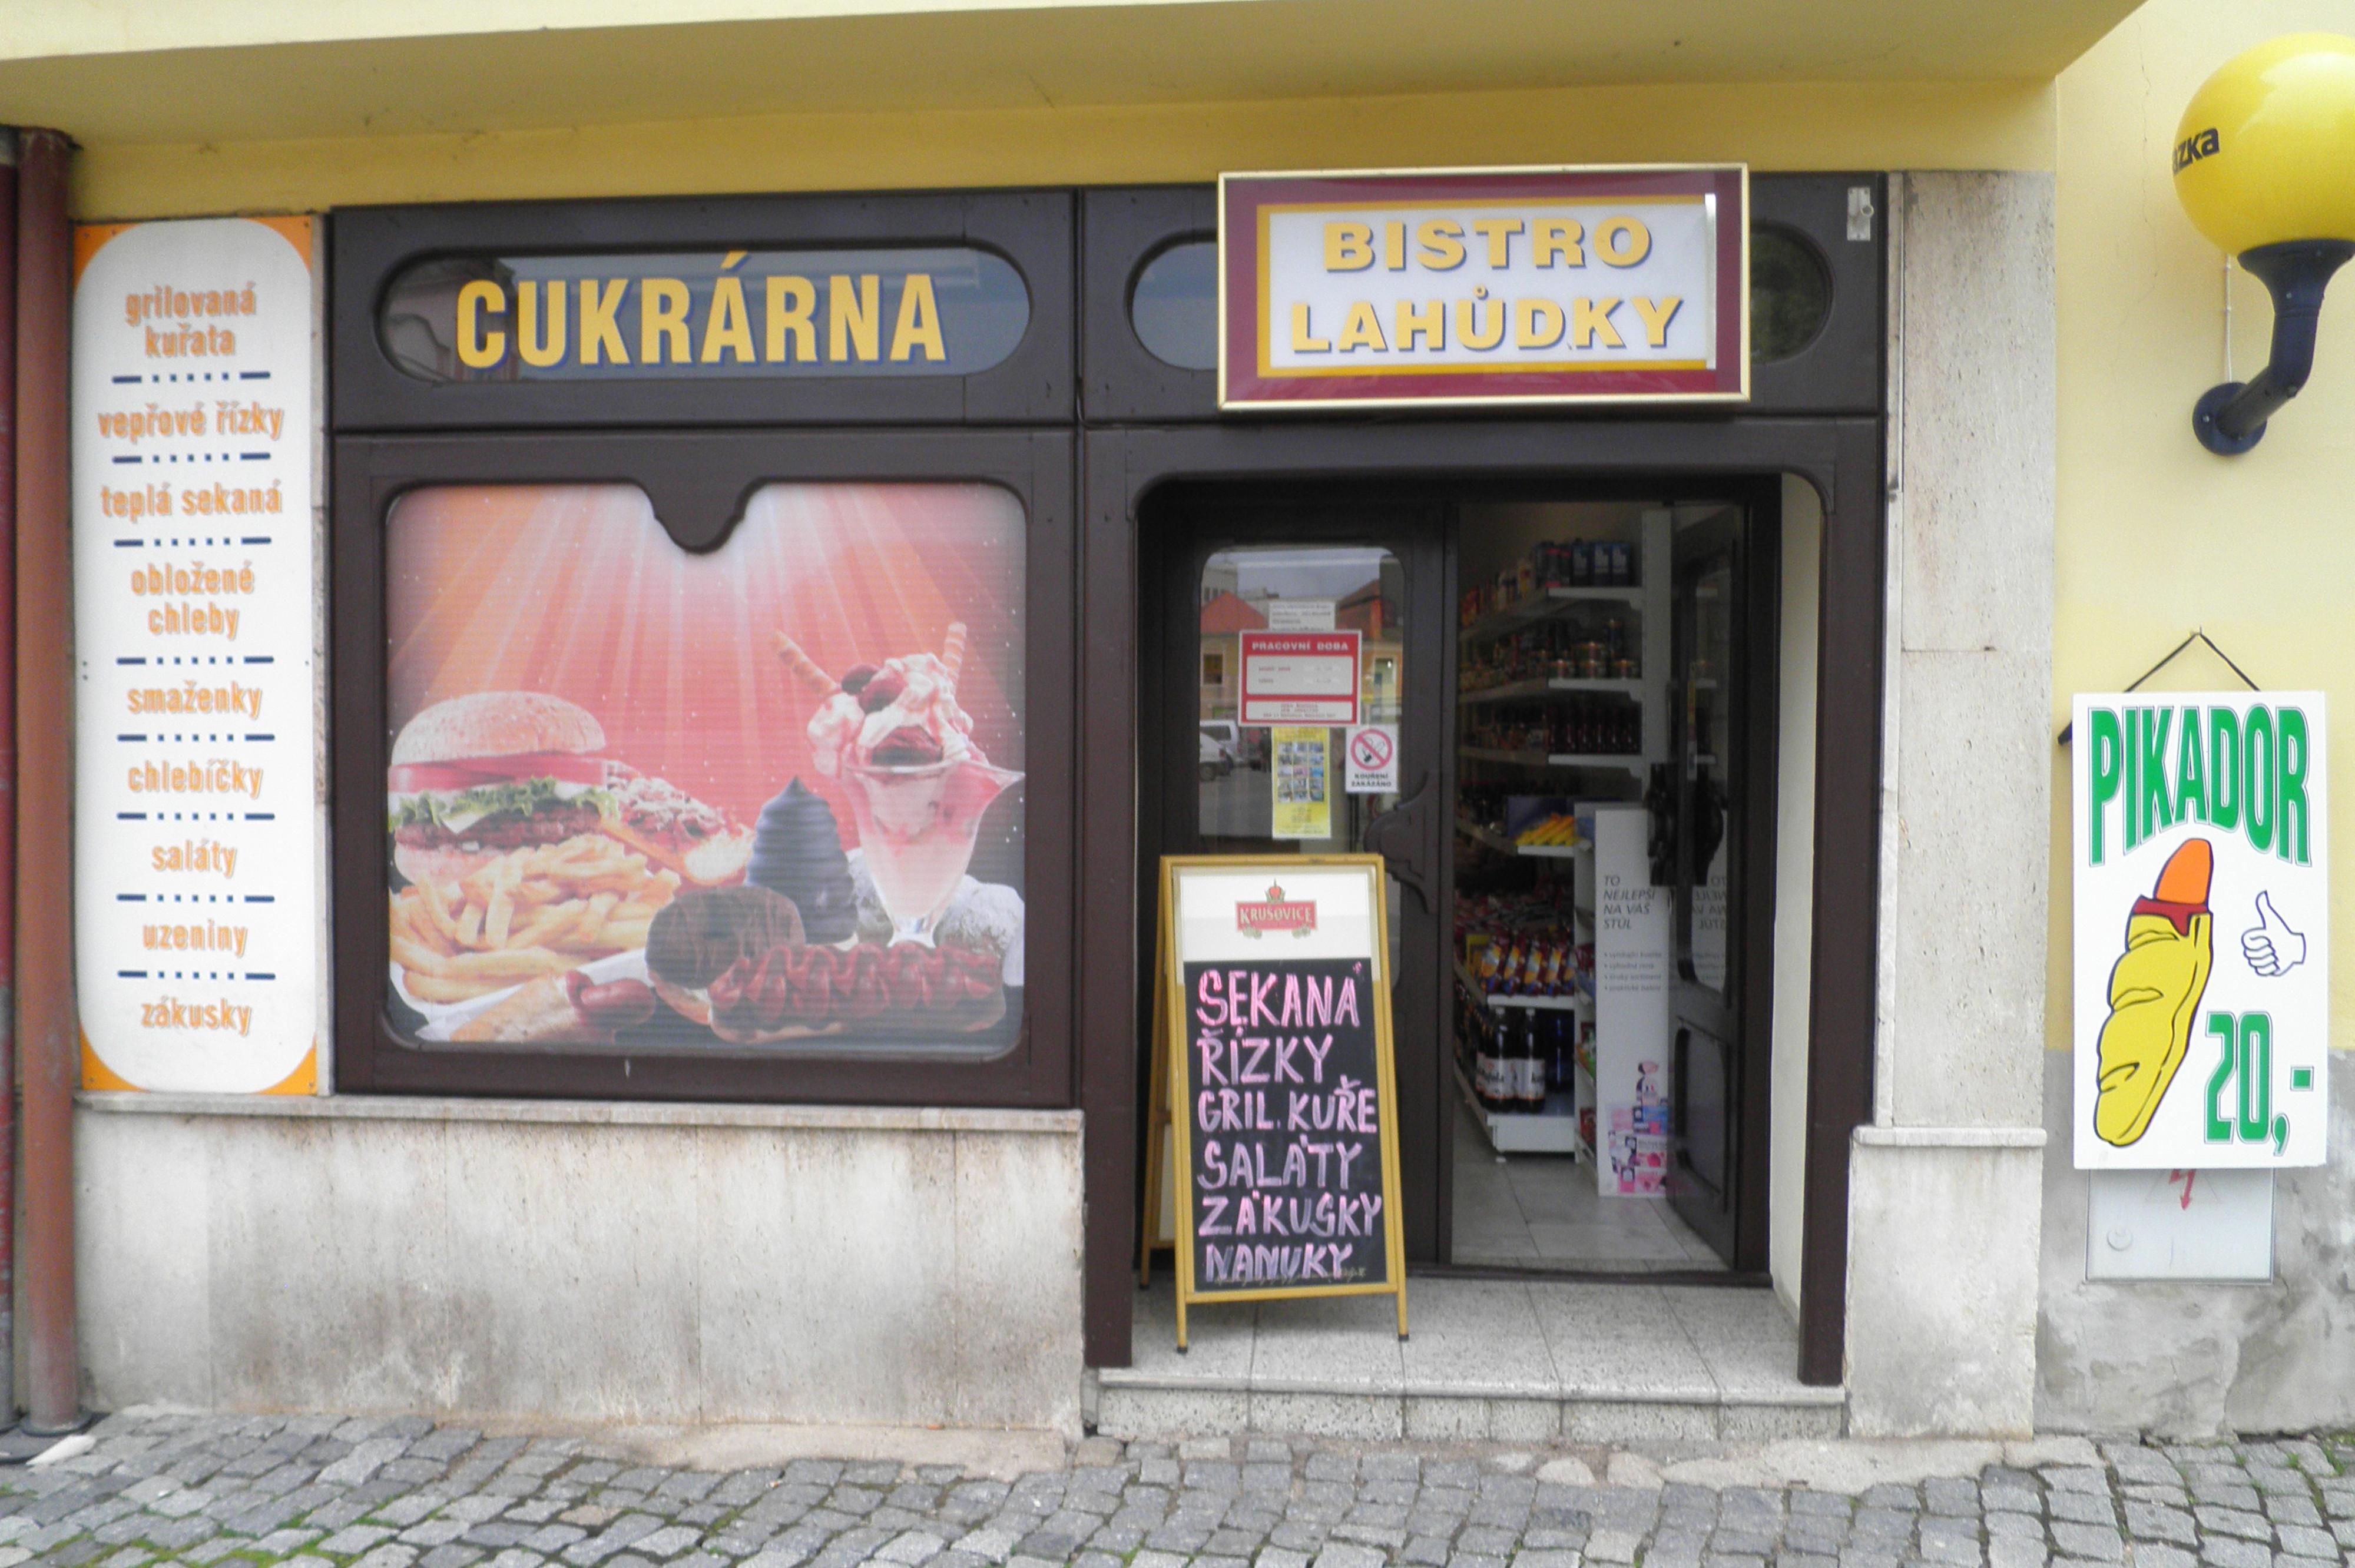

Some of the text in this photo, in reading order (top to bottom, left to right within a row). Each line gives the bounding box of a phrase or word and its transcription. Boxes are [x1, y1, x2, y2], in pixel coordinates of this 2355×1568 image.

[1323, 216, 1652, 273] BISTRO
[125, 282, 256, 326] grilovaná
[456, 251, 946, 369] CUKRÁRNA
[1291, 284, 1682, 353] LAHŮDKY
[145, 324, 236, 357] kuřata
[97, 402, 284, 443] vepřové řízky
[101, 479, 282, 523] teplá sekaná
[131, 561, 254, 595] obložené
[148, 602, 239, 639] chleby
[1252, 642, 1349, 651] PRACOVNÍ DOBA
[127, 681, 263, 718] smaženky
[127, 758, 264, 799] chlebíčky
[2088, 704, 2311, 867] PIKADOR
[151, 838, 237, 878] saláty
[142, 920, 248, 958] uzeniny
[141, 995, 252, 1036] zákusky
[1196, 962, 1362, 1027] SEKANÁ
[1196, 1026, 1333, 1085] ŘÍZKY
[1198, 1075, 1377, 1133] GRIL. KUŘE
[2203, 1010, 2314, 1155] 20,-
[1197, 1134, 1362, 1190] SALÁTY
[1198, 1189, 1382, 1237] ZÁKUSKY
[1205, 1242, 1353, 1282] NANUKY
